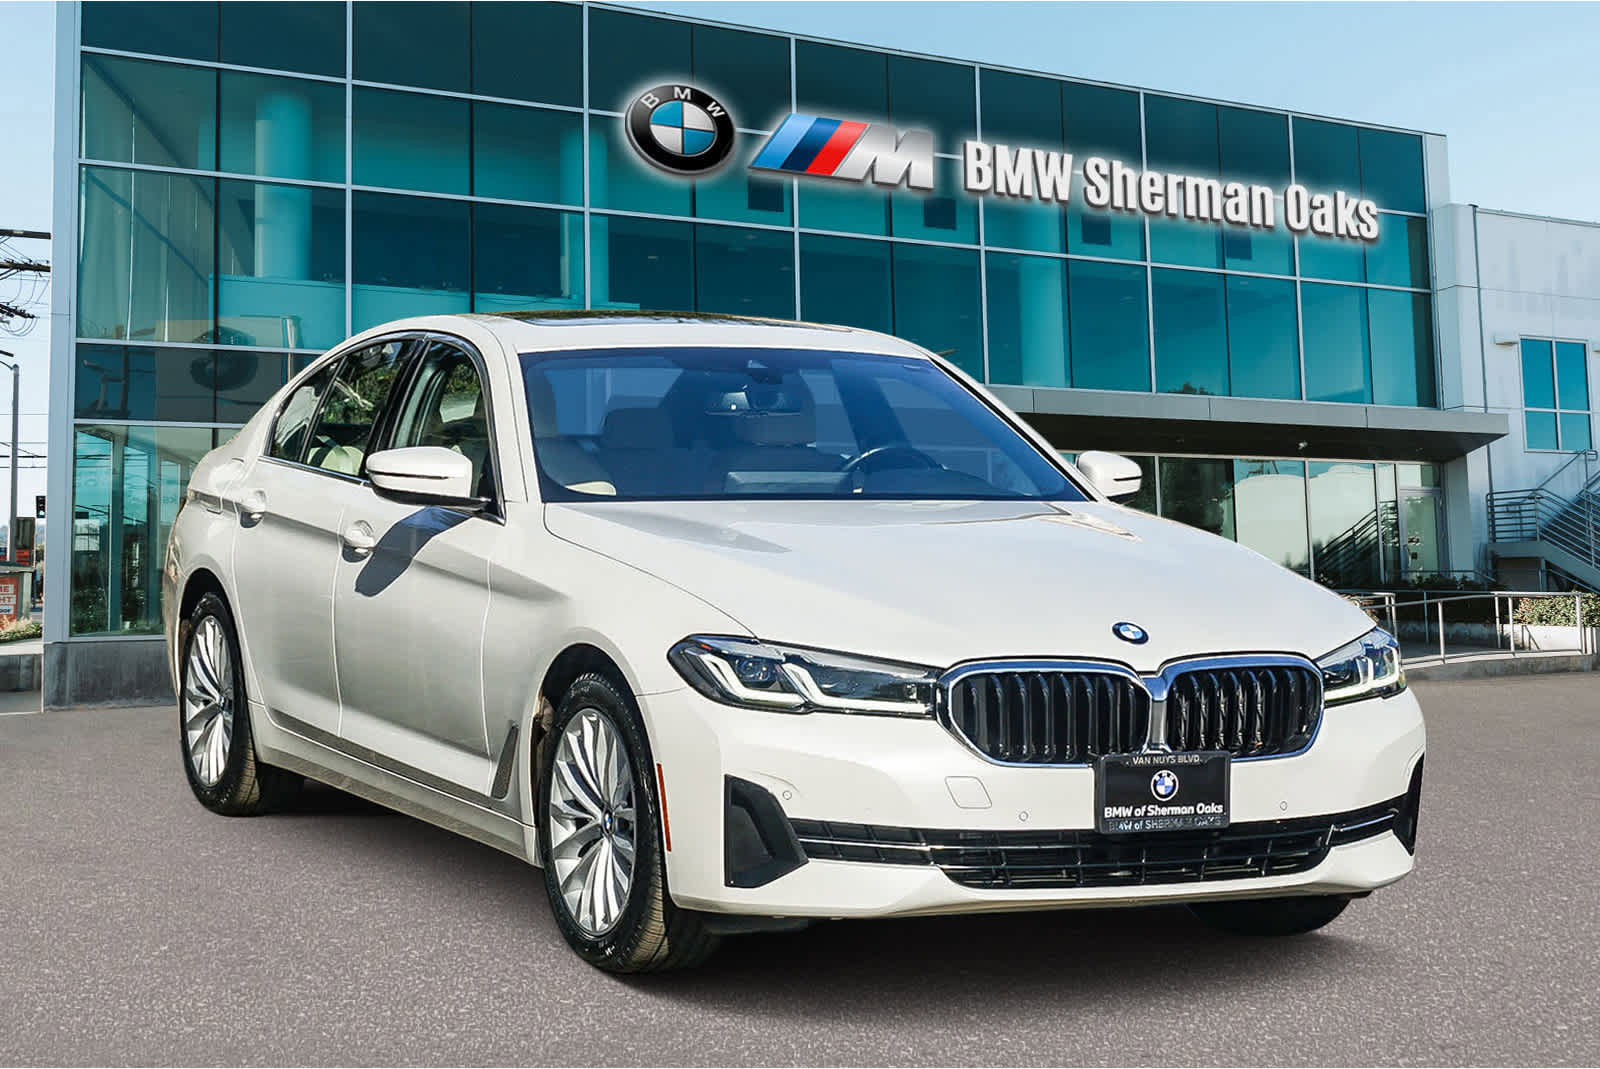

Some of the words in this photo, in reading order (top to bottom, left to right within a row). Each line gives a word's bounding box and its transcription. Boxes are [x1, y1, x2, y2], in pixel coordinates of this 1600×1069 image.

[963, 140, 1073, 201] BMW
[1083, 156, 1275, 230] Sherman
[1284, 183, 1380, 242] Oaks
[1132, 756, 1151, 765] VAN
[1152, 755, 1177, 764] NUYS
[1103, 806, 1133, 819] BMW
[1134, 805, 1146, 817] of
[1147, 804, 1195, 816] Sherman
[1196, 802, 1224, 814] Oaks
